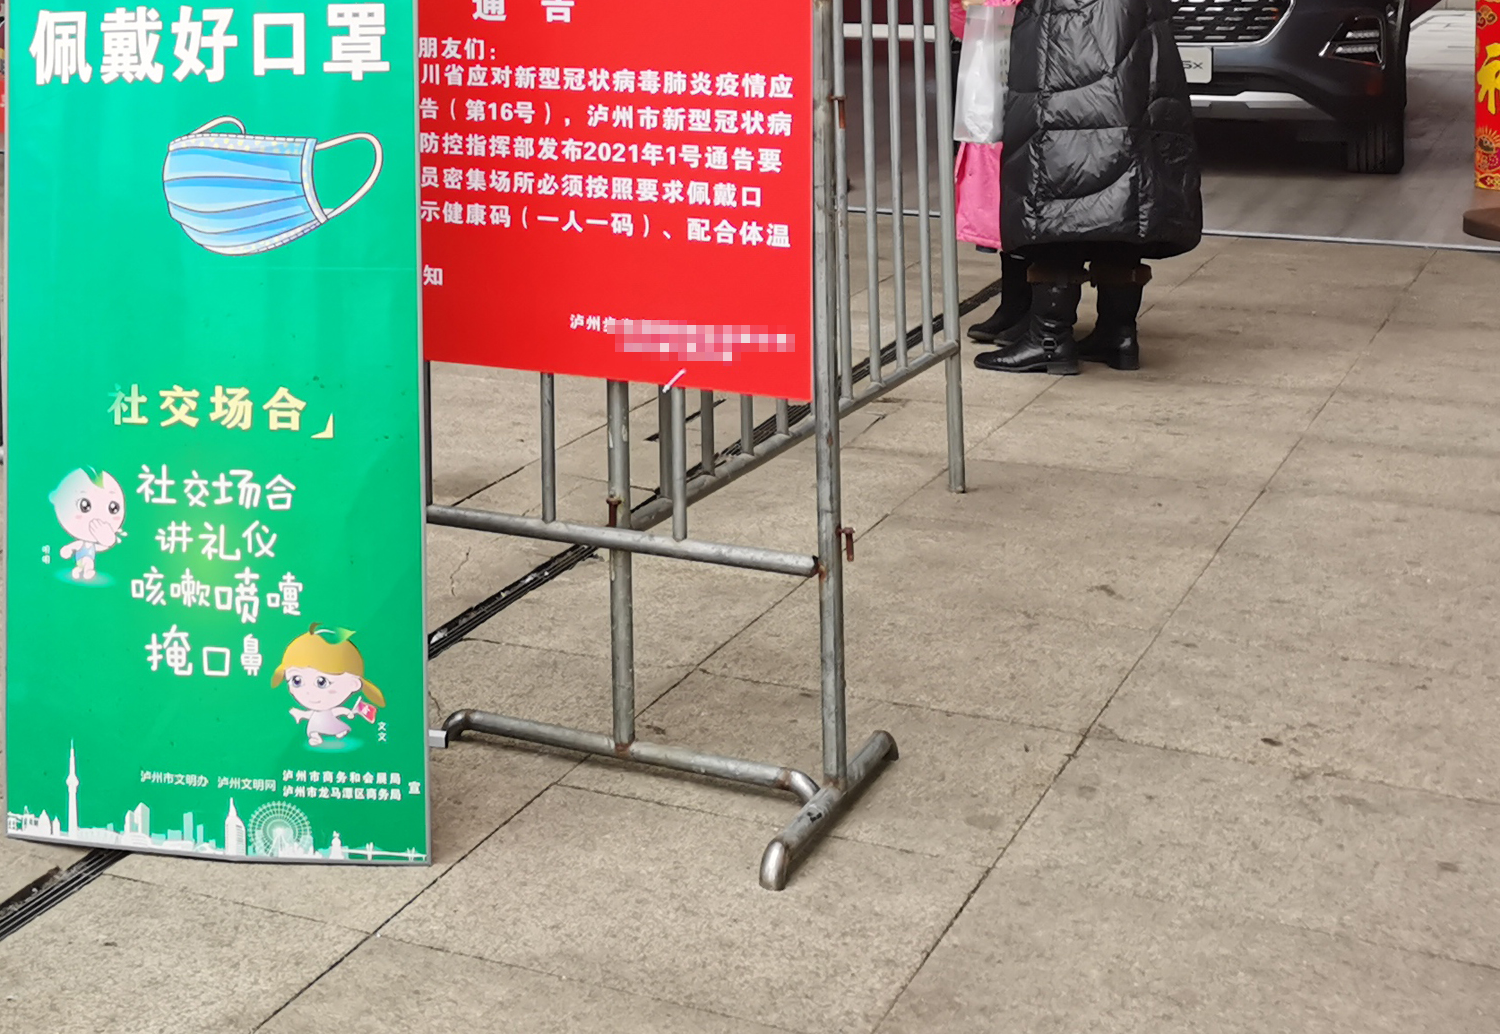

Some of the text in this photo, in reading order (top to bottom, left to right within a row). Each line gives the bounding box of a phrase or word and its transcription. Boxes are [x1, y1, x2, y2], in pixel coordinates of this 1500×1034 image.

[29, 2, 391, 85] 佩戴好口罩
[417, 36, 498, 62] 朋友们：
[420, 65, 794, 99] 川省应对新型冠状病毒肺炎疫情应
[419, 131, 783, 174] 防控指挥部发布2021年1号通告要
[420, 166, 762, 209] 员密集场所必须按照要求佩戴口
[422, 264, 444, 287] 知
[135, 464, 296, 511] 社交场合
[155, 519, 278, 561] 讲礼仪
[130, 565, 304, 624] 咳嗽喷嚏
[144, 623, 264, 678] 掩口鼻
[377, 721, 388, 743] 文文
[140, 769, 209, 788] 泸州市文明办
[217, 775, 277, 793] 泸州文明网
[282, 769, 402, 786] 泸州市商务和会展局
[282, 786, 403, 802] 泸州市龙马潭区商务局
